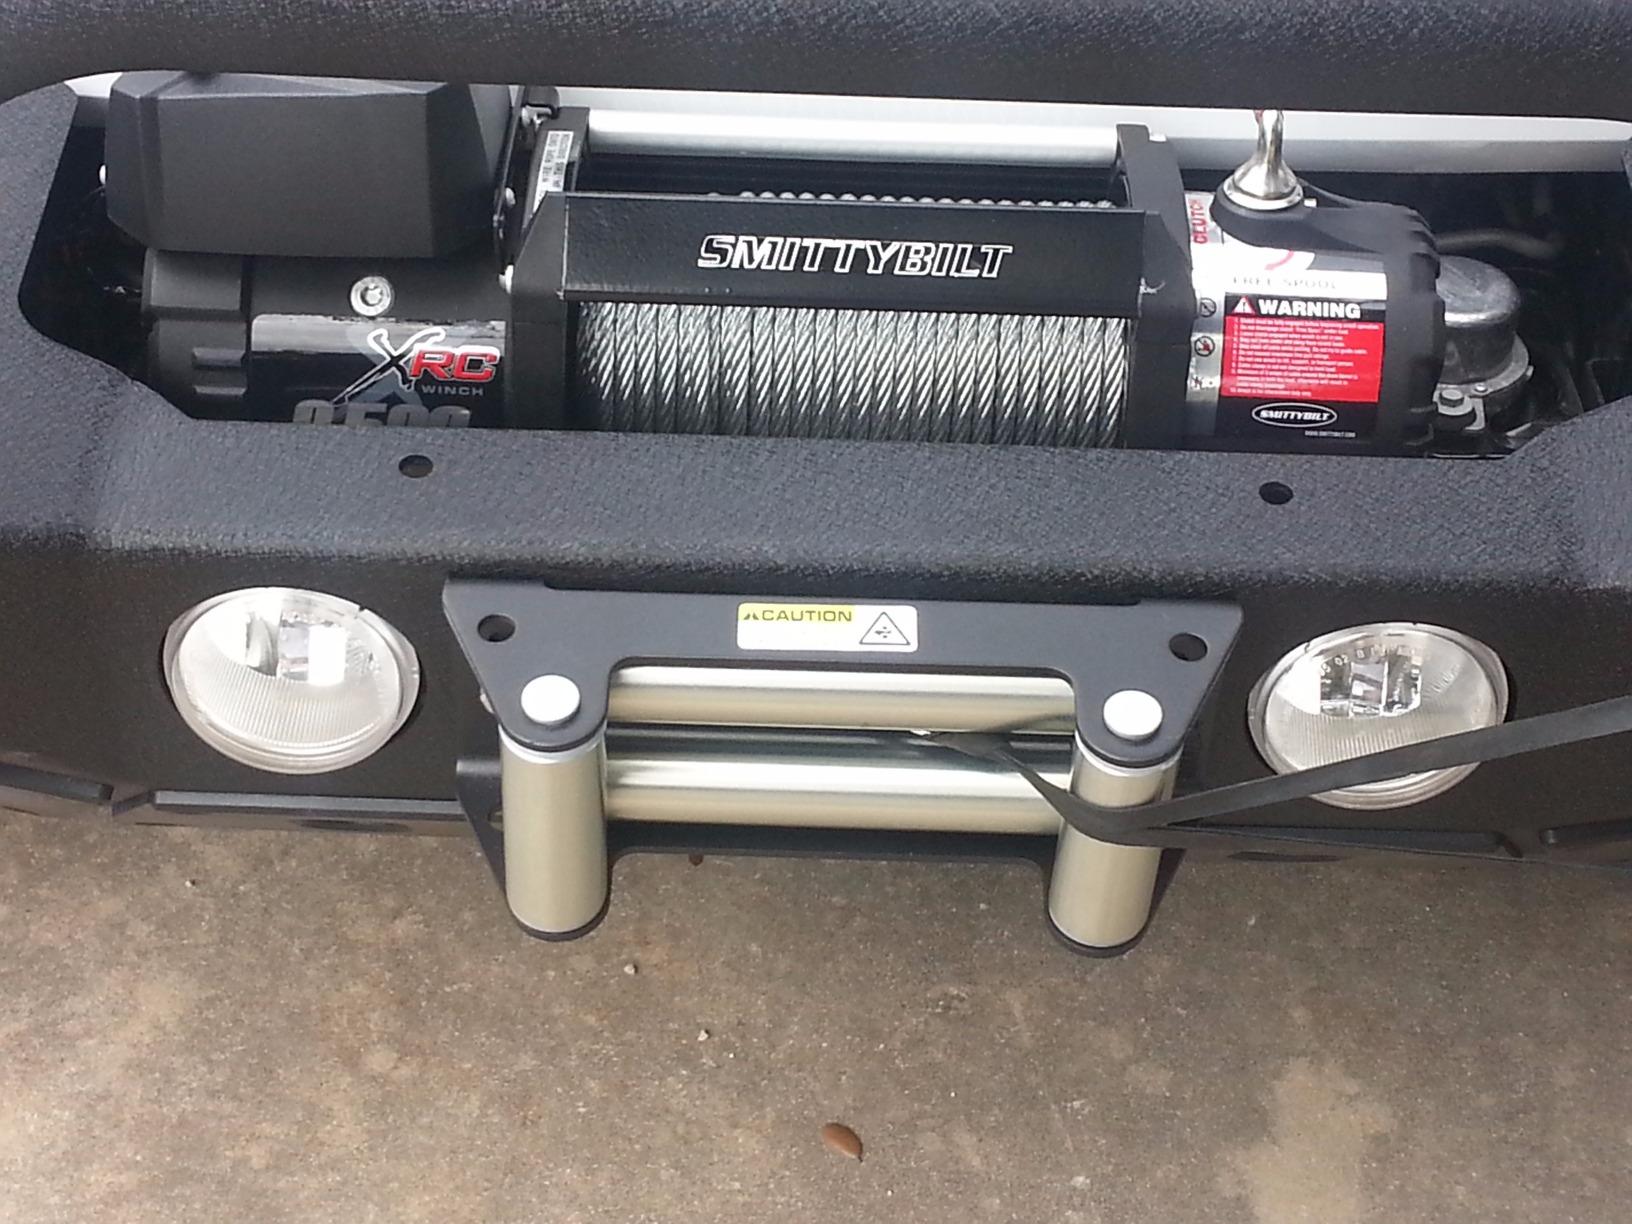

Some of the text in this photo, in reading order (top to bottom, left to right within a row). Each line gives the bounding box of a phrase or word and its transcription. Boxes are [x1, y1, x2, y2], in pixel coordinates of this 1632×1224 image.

[697, 234, 1014, 278] SMITTYBILT
[1258, 299, 1361, 319] WARNING
[421, 384, 484, 396] WINCH
[762, 609, 852, 622] CAUTION
